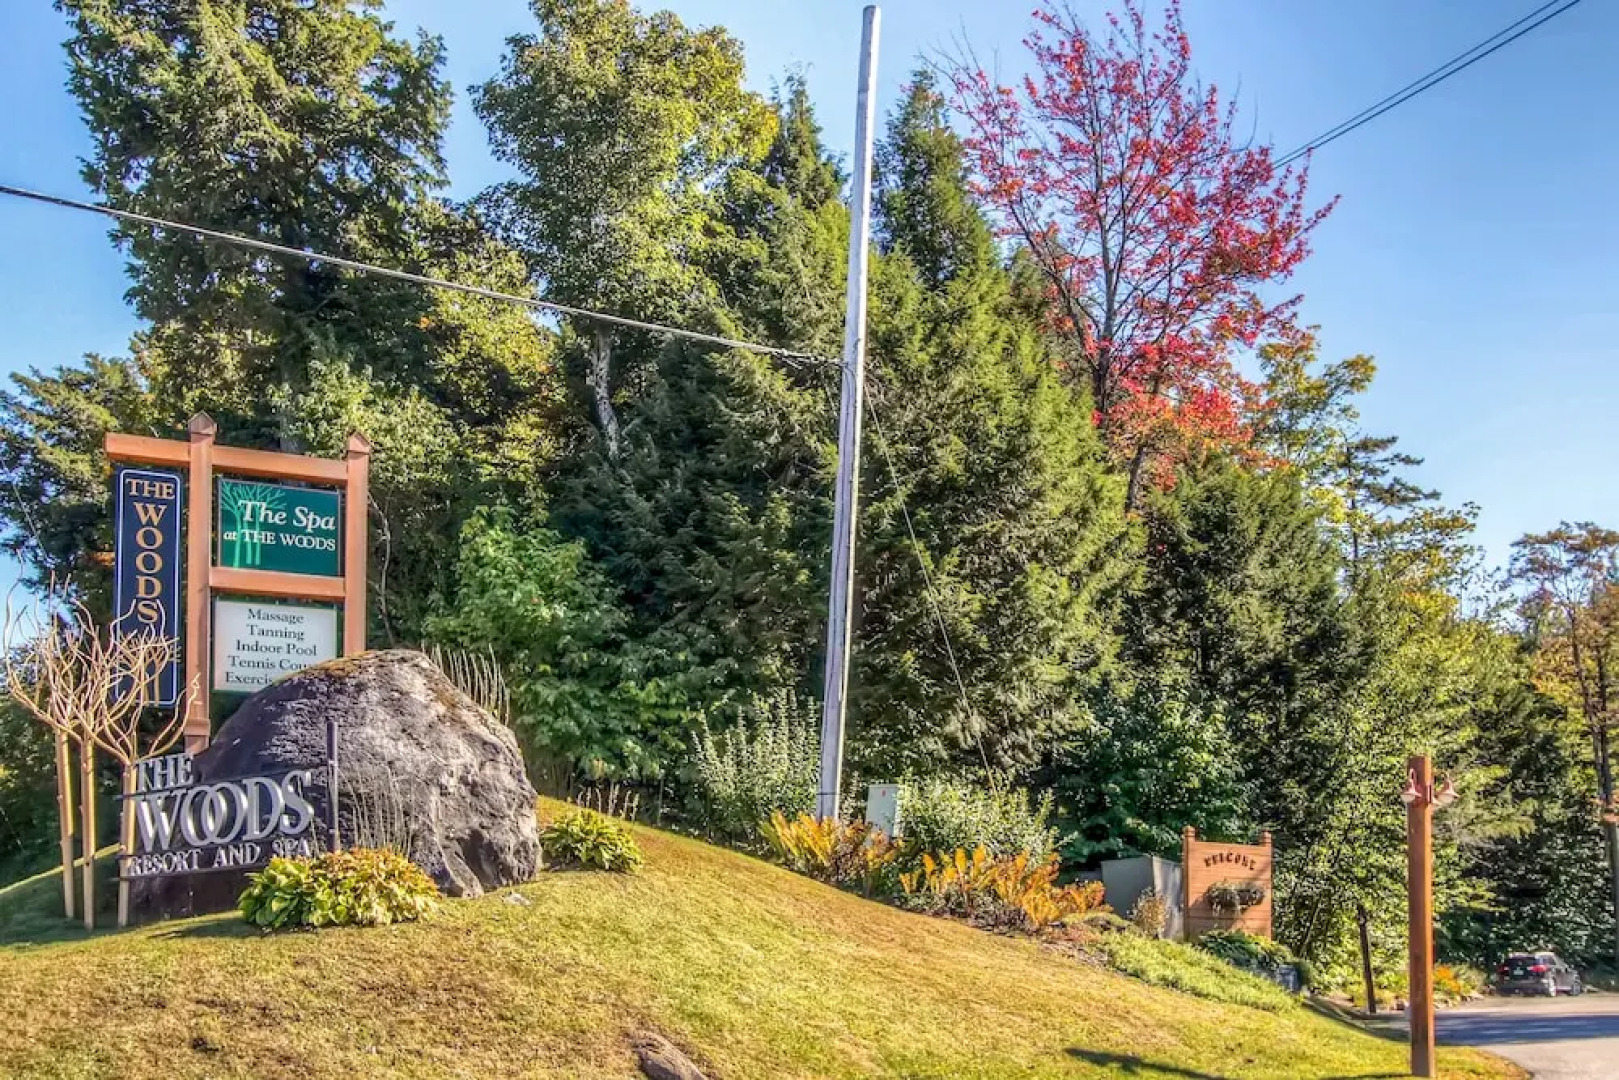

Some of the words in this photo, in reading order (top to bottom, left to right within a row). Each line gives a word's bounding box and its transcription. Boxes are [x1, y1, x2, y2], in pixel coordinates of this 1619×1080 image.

[126, 478, 176, 500] THE
[238, 500, 287, 525] The
[293, 506, 336, 533] Spa
[223, 531, 237, 541] at
[241, 529, 276, 545] THE
[280, 534, 336, 551] WOODS
[134, 501, 167, 623] WOODS
[248, 608, 304, 625] Massage
[246, 624, 304, 641] Tanning
[236, 640, 283, 654] Indoor
[286, 643, 317, 656] Pool
[228, 654, 275, 669] Tennis
[280, 658, 308, 670] Cou
[225, 671, 273, 684] Exercis
[137, 753, 194, 793] THE
[134, 770, 315, 852] WOODS
[128, 850, 203, 876] RESORT
[212, 842, 261, 868] AND
[271, 838, 314, 860] SPA
